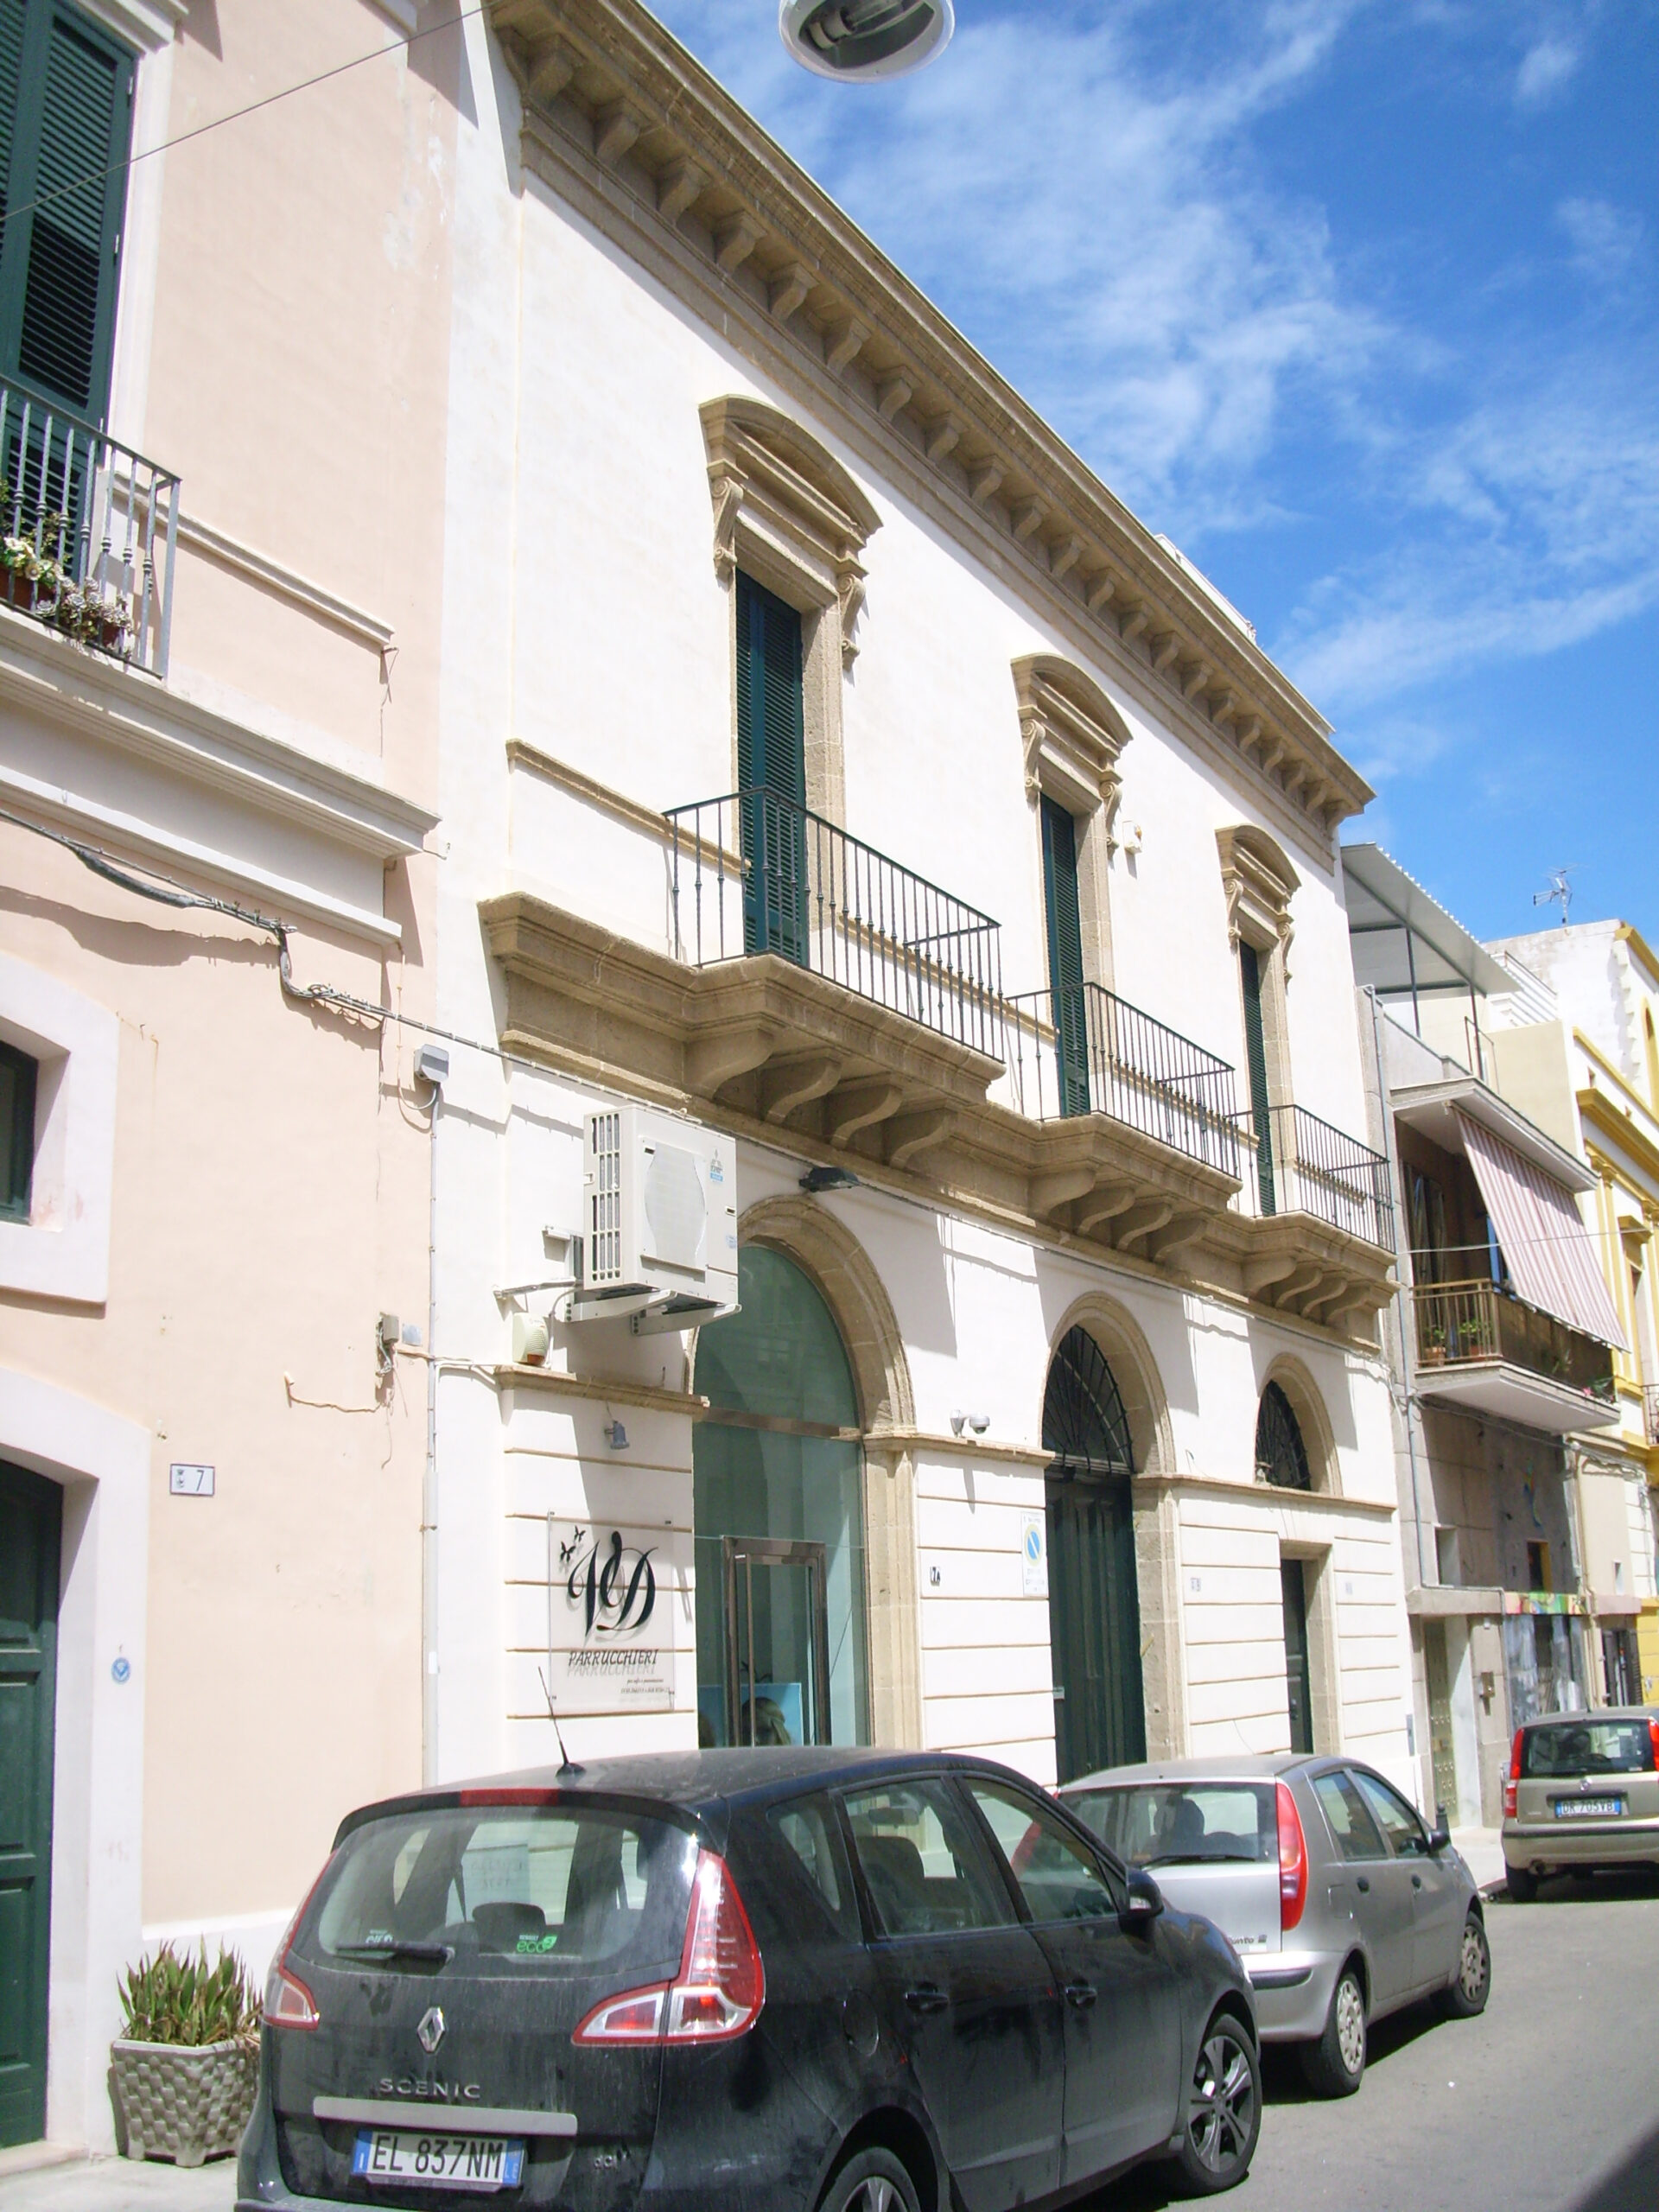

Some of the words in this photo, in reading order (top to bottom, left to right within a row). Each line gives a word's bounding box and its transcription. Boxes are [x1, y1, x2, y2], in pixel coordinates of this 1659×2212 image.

[196, 1469, 205, 1491] 7
[568, 1649, 658, 1667] PARRUCCHIERI
[379, 2078, 480, 2099] SCENIC
[372, 2134, 404, 2171] EL
[415, 2138, 504, 2179] 837NM
